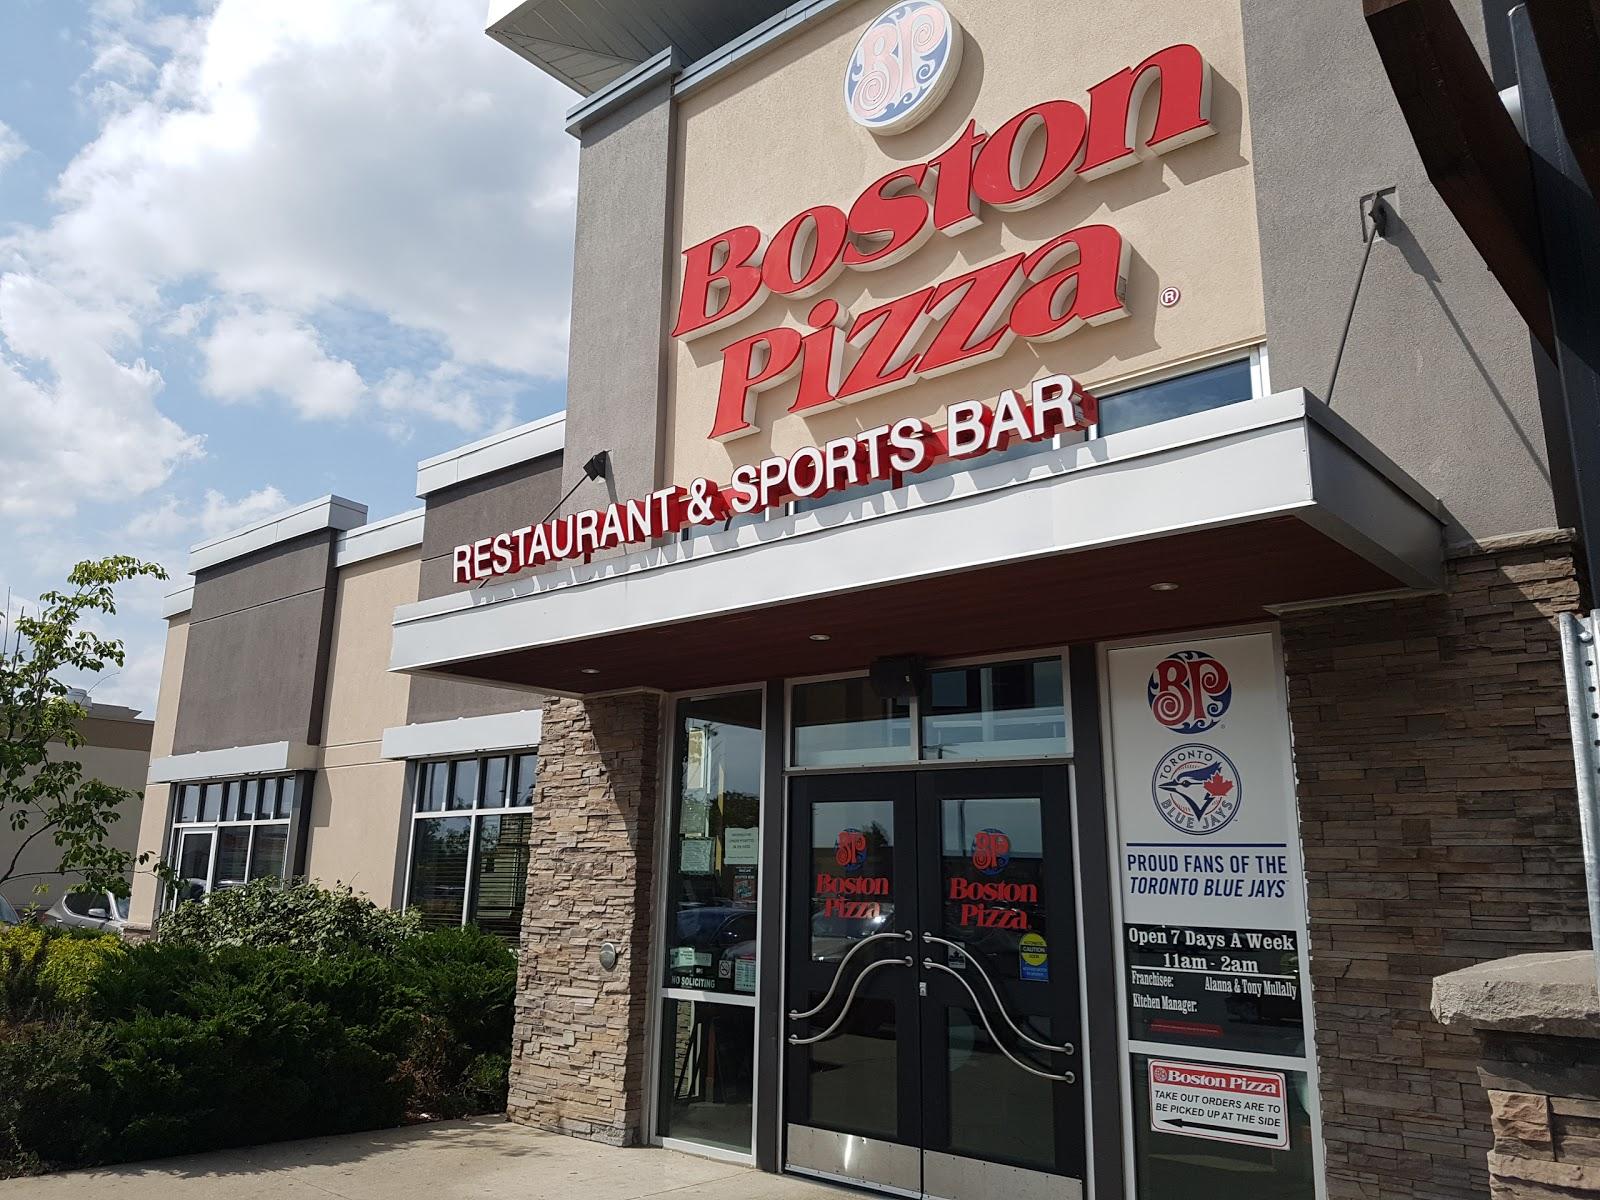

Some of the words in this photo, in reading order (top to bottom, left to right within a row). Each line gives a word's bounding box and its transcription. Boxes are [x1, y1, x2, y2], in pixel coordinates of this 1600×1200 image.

[671, 43, 1209, 338] Boston
[708, 223, 1123, 440] Pizza
[453, 485, 676, 583] RESTAURANT
[687, 478, 715, 524] &
[731, 417, 926, 513] SPORTS
[947, 373, 1077, 457] BAR
[1151, 658, 1230, 726] BP
[1160, 750, 1213, 780] TORONTO
[1161, 798, 1195, 829] BLUE
[1202, 800, 1234, 830] JAYS
[1127, 854, 1179, 872] PROUD
[1184, 855, 1224, 873] FANS
[1230, 855, 1250, 874] OF
[1255, 855, 1288, 874] THE
[816, 873, 890, 896] Boston
[949, 877, 1038, 903] Boston
[1130, 876, 1199, 896] TORONTO
[1203, 879, 1245, 898] BLUE
[1248, 879, 1287, 898] JAYS
[824, 896, 881, 919] Pizza
[960, 903, 1029, 930] Pizza
[1128, 927, 1168, 946] Open
[1170, 930, 1180, 945] 7
[1184, 930, 1226, 950] Days
[1230, 932, 1243, 948] A
[1246, 933, 1295, 951] Week
[1163, 953, 1208, 970] 11am
[1220, 955, 1259, 973] 2am
[681, 976, 716, 989] SOLICITING
[1131, 970, 1175, 988] Franchisee:
[1204, 976, 1233, 993] Alanna
[1234, 978, 1241, 993] &
[1241, 978, 1262, 998] Tony
[1264, 980, 1297, 1001] Mullally
[1132, 993, 1161, 1010] Kitchen
[1167, 1070, 1227, 1089] Boston
[1229, 1077, 1277, 1094] Pizza
[1154, 1090, 1178, 1101] TAKE
[1180, 1093, 1200, 1104] OUT
[1202, 1095, 1242, 1109] ORDERS
[1244, 1101, 1265, 1112] ARE
[1268, 1104, 1281, 1114] TO
[1155, 1102, 1168, 1112] BE
[1170, 1104, 1205, 1117] PICKED
[1207, 1109, 1220, 1119] UP
[1221, 1112, 1233, 1121] AT
[1236, 1113, 1256, 1124] THE
[1258, 1117, 1281, 1128] SIDE
